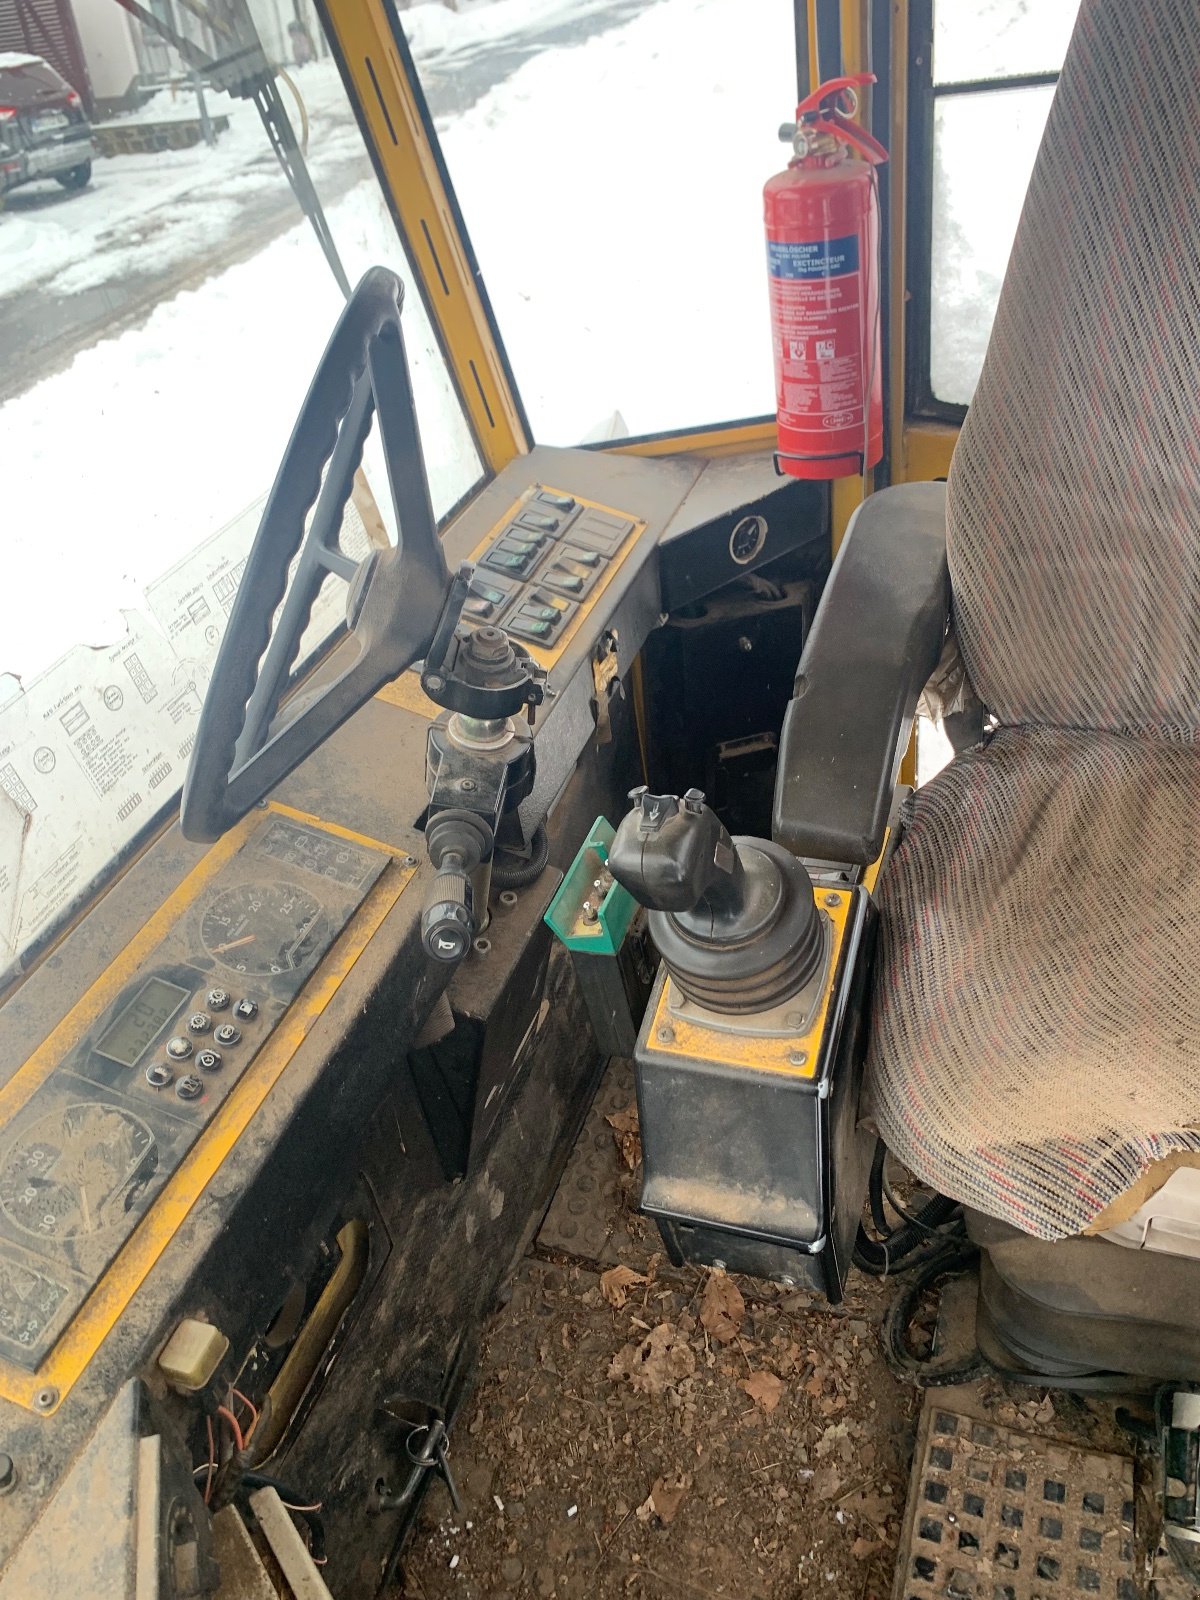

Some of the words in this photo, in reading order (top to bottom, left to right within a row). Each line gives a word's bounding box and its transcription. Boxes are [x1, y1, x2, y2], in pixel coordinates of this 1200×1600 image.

[248, 900, 262, 912] 20
[279, 904, 294, 915] 25
[218, 916, 232, 927] 15
[236, 964, 247, 973] 5
[26, 1150, 45, 1169] 30
[18, 1187, 38, 1206] 20
[38, 1214, 56, 1233] 10
